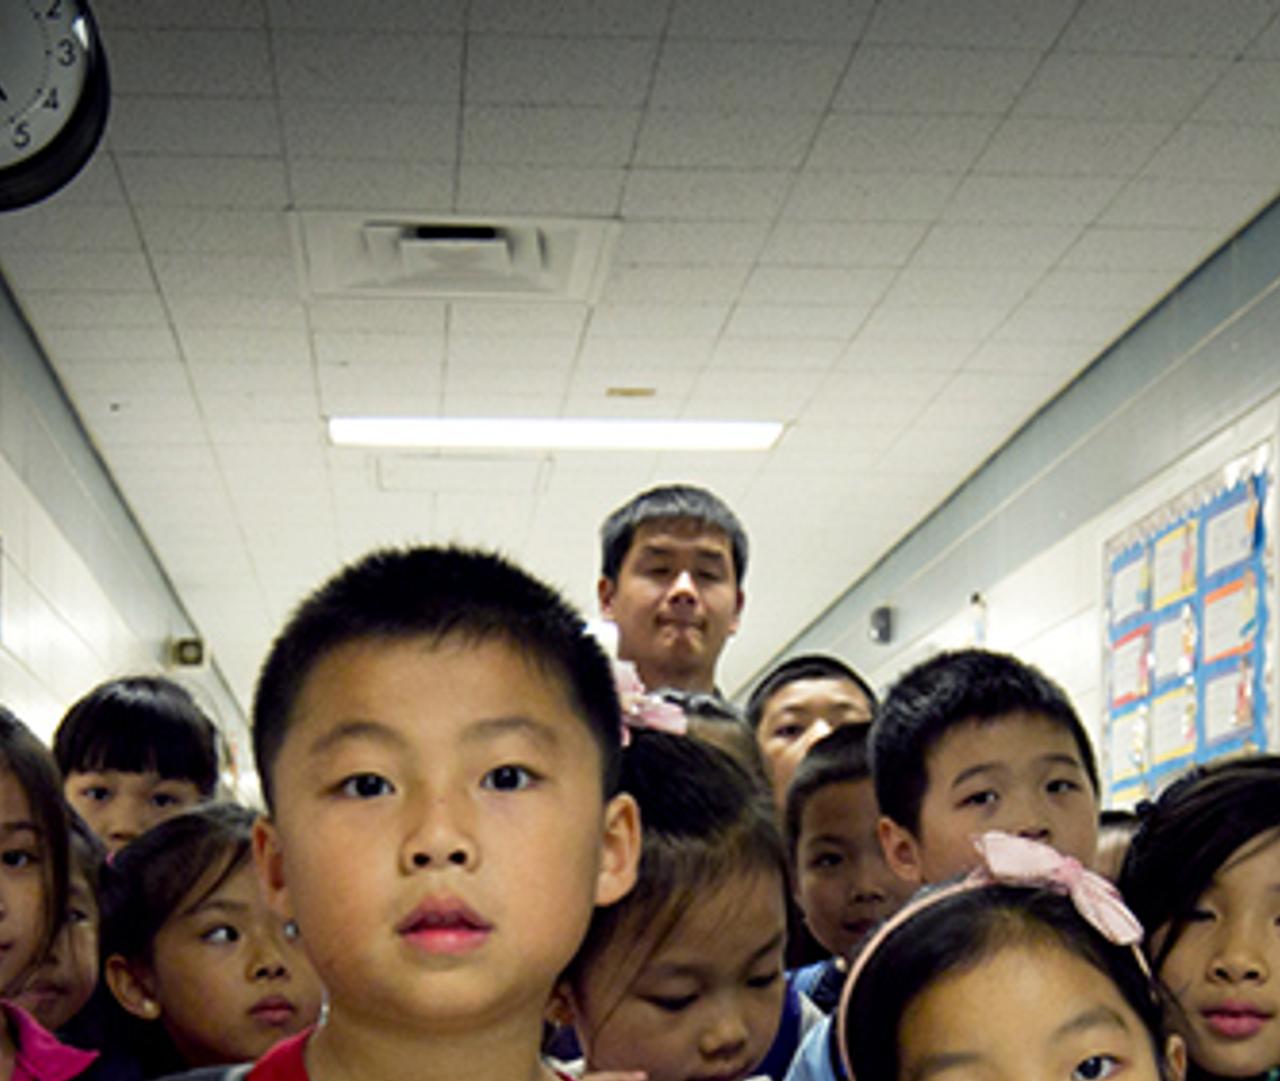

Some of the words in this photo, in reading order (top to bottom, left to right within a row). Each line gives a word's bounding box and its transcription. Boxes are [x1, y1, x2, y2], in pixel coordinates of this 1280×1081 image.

[58, 40, 76, 67] 3
[43, 87, 60, 110] 4
[13, 122, 31, 149] 5
